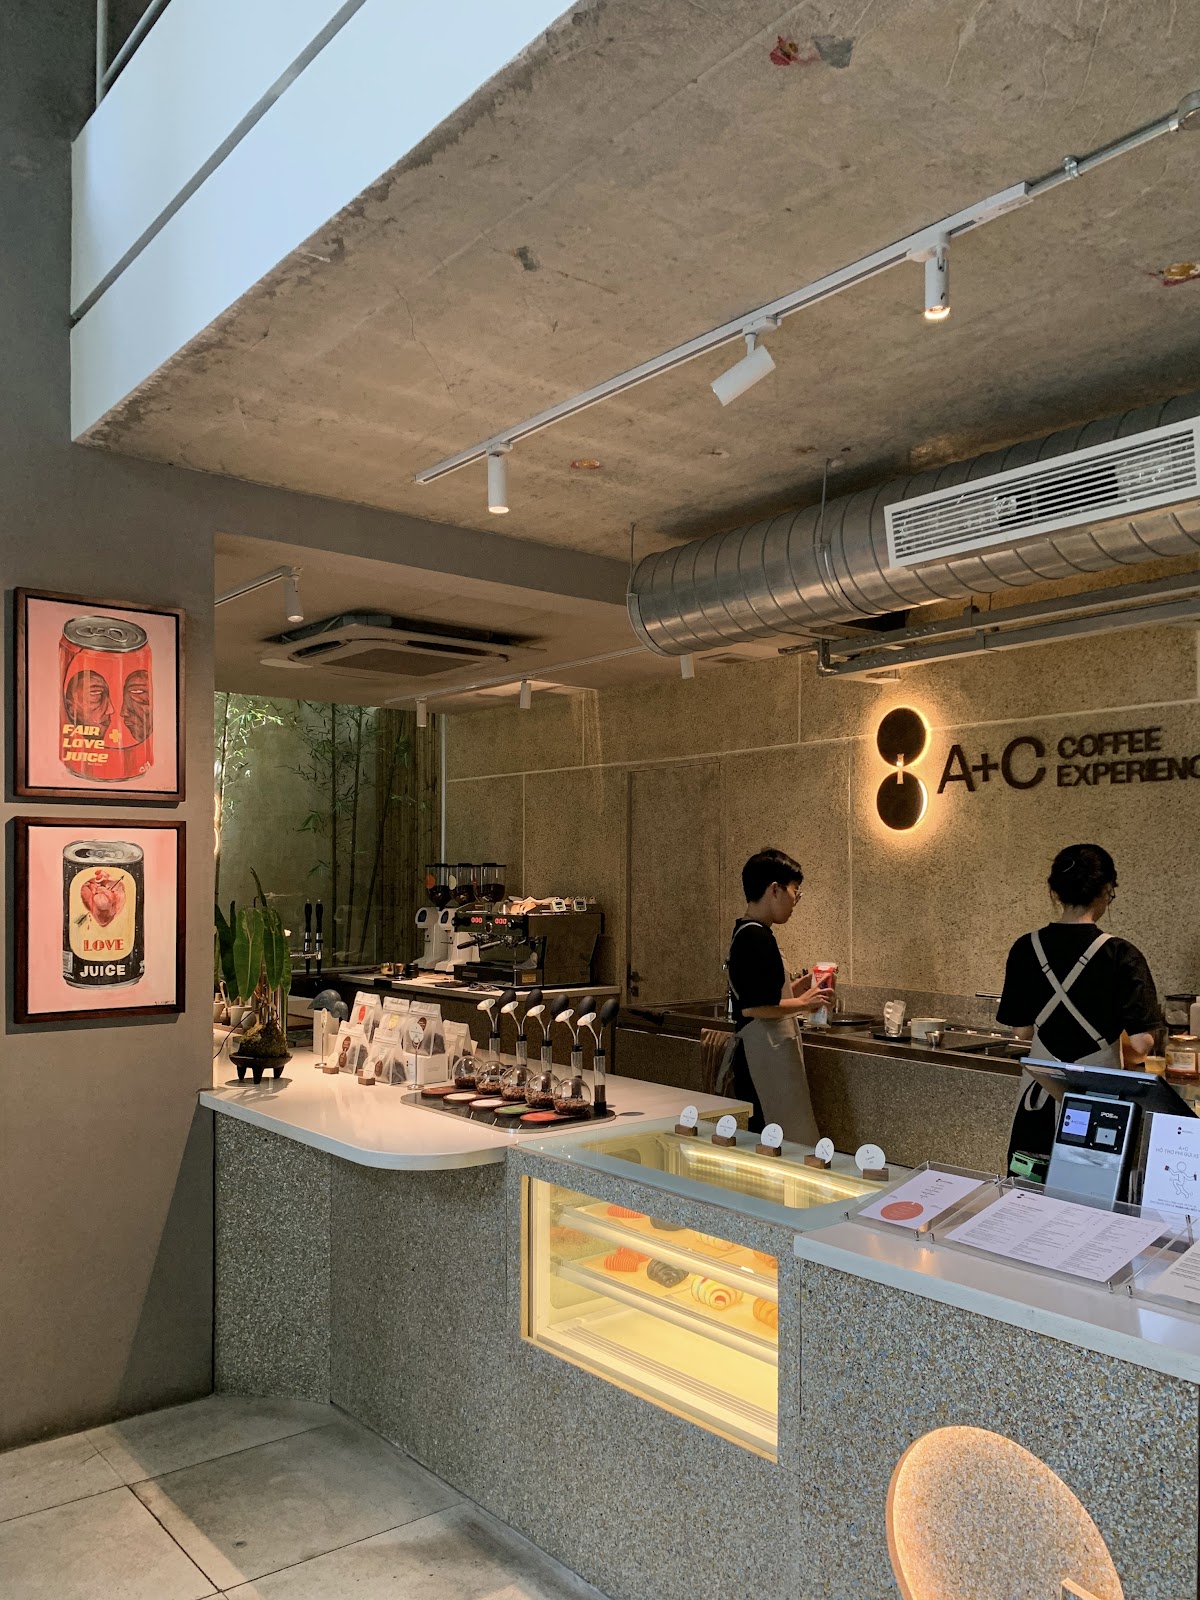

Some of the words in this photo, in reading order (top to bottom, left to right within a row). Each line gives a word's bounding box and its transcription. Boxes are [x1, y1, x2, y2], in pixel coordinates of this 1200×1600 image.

[62, 724, 100, 737] FAIR
[62, 737, 105, 750] LOVE
[1057, 727, 1162, 760] COFFEE
[63, 751, 109, 763] JUICE
[937, 736, 1046, 794] A+C
[83, 938, 124, 952] LOVE
[79, 964, 126, 978] JUICE
